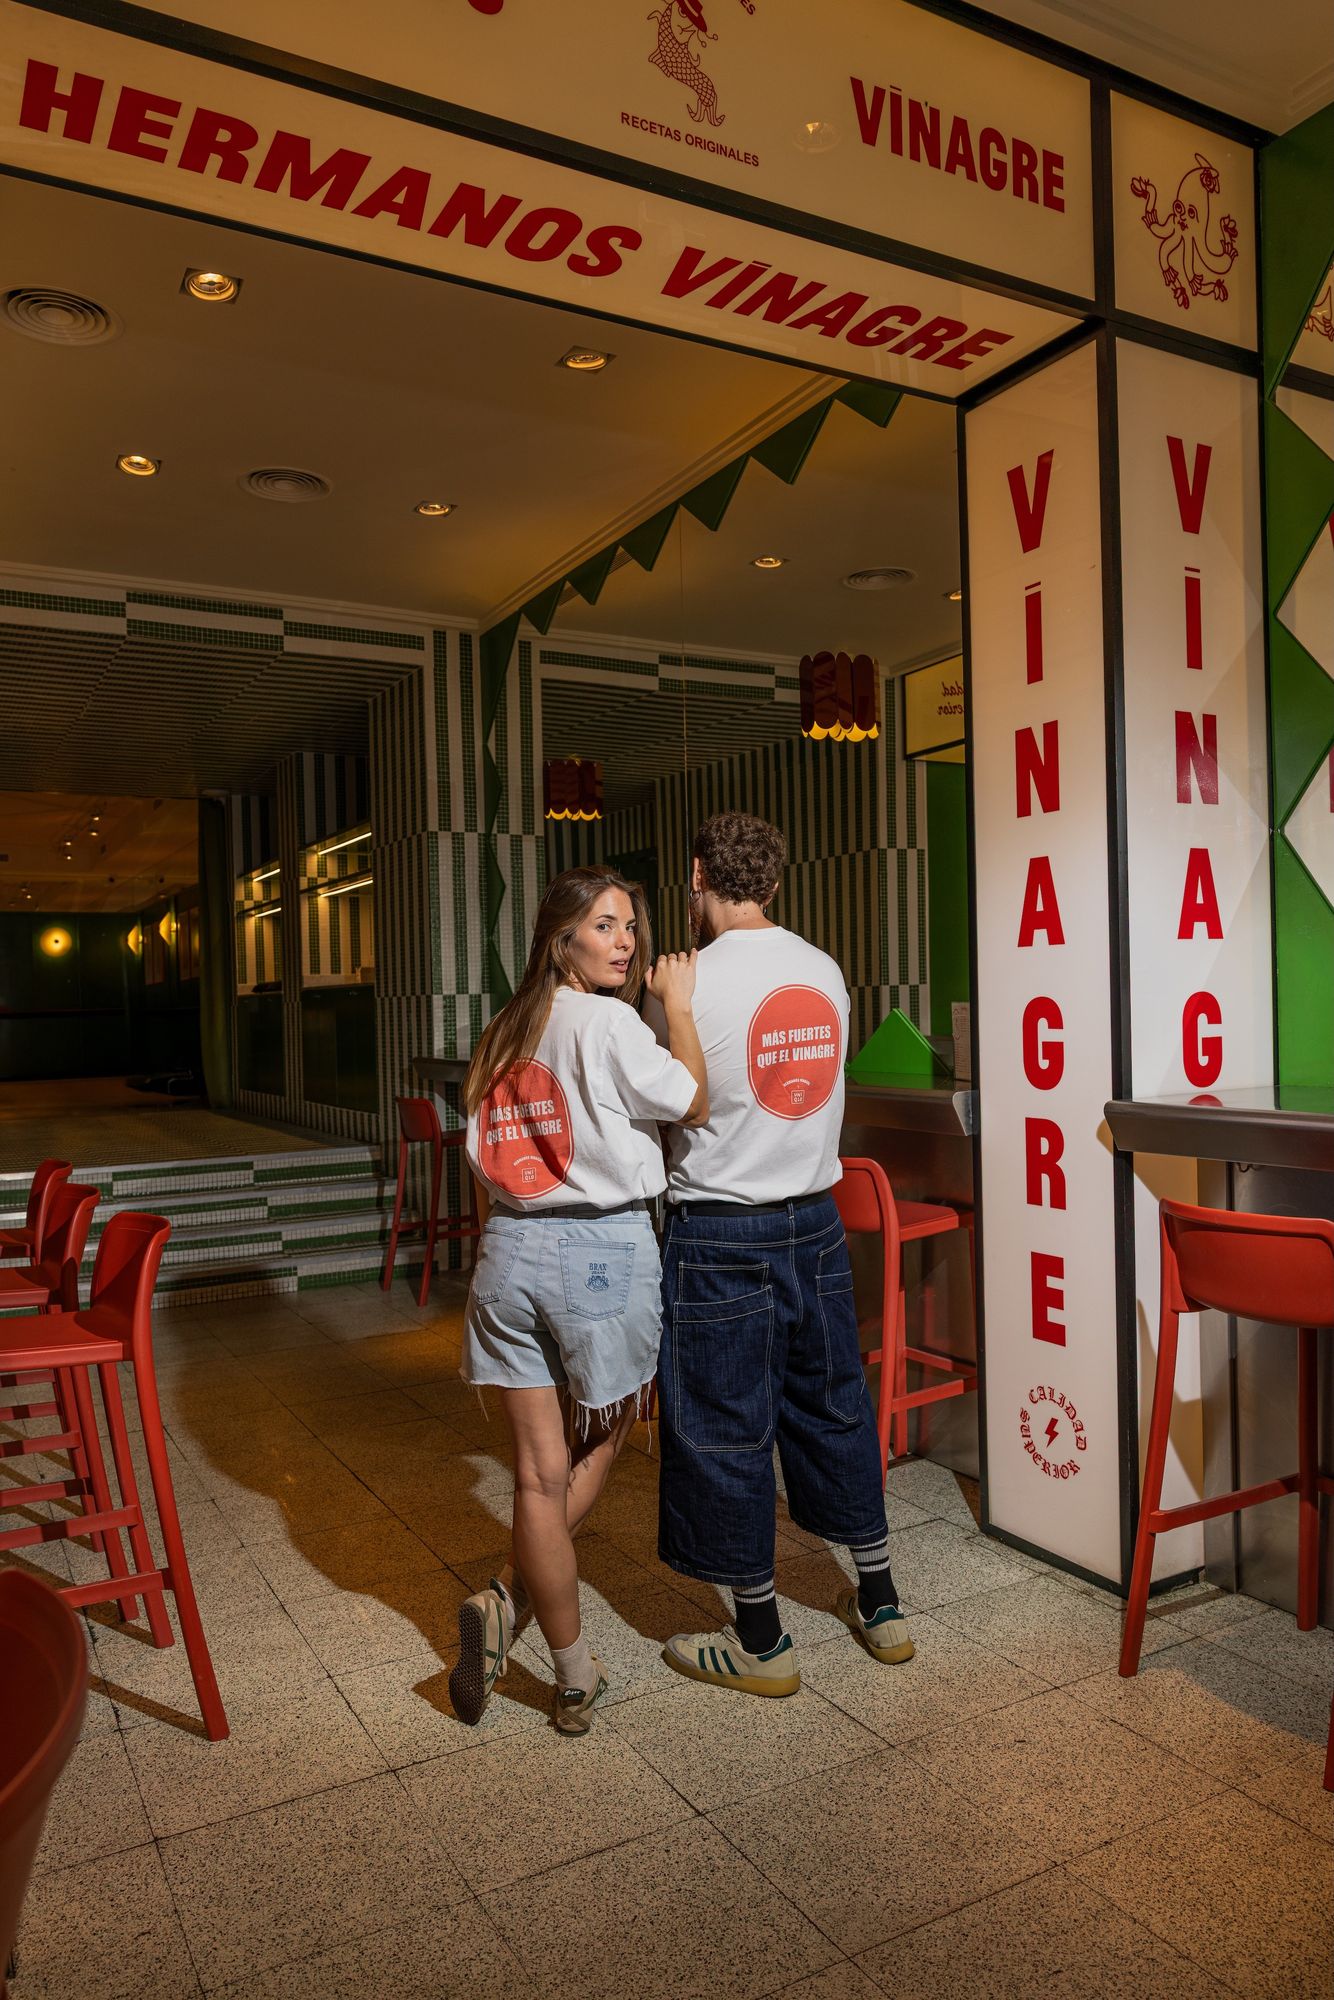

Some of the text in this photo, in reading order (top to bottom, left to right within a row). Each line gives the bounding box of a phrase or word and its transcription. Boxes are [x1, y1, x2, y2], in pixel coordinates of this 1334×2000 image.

[621, 112, 759, 167] RECETAS ORIGINALES
[19, 58, 642, 277] HERMANOS
[762, 1024, 831, 1048] MÁS FUERTES
[757, 1043, 835, 1069] QUE EL VINAGRE
[490, 1099, 555, 1125] MÁS FUERTES
[486, 1118, 562, 1146] QUE EL VINAGRE
[589, 1263, 607, 1271] BRAX
[1028, 1385, 1087, 1451] CALIDAD
[1019, 1406, 1081, 1480] SUPERIOR
